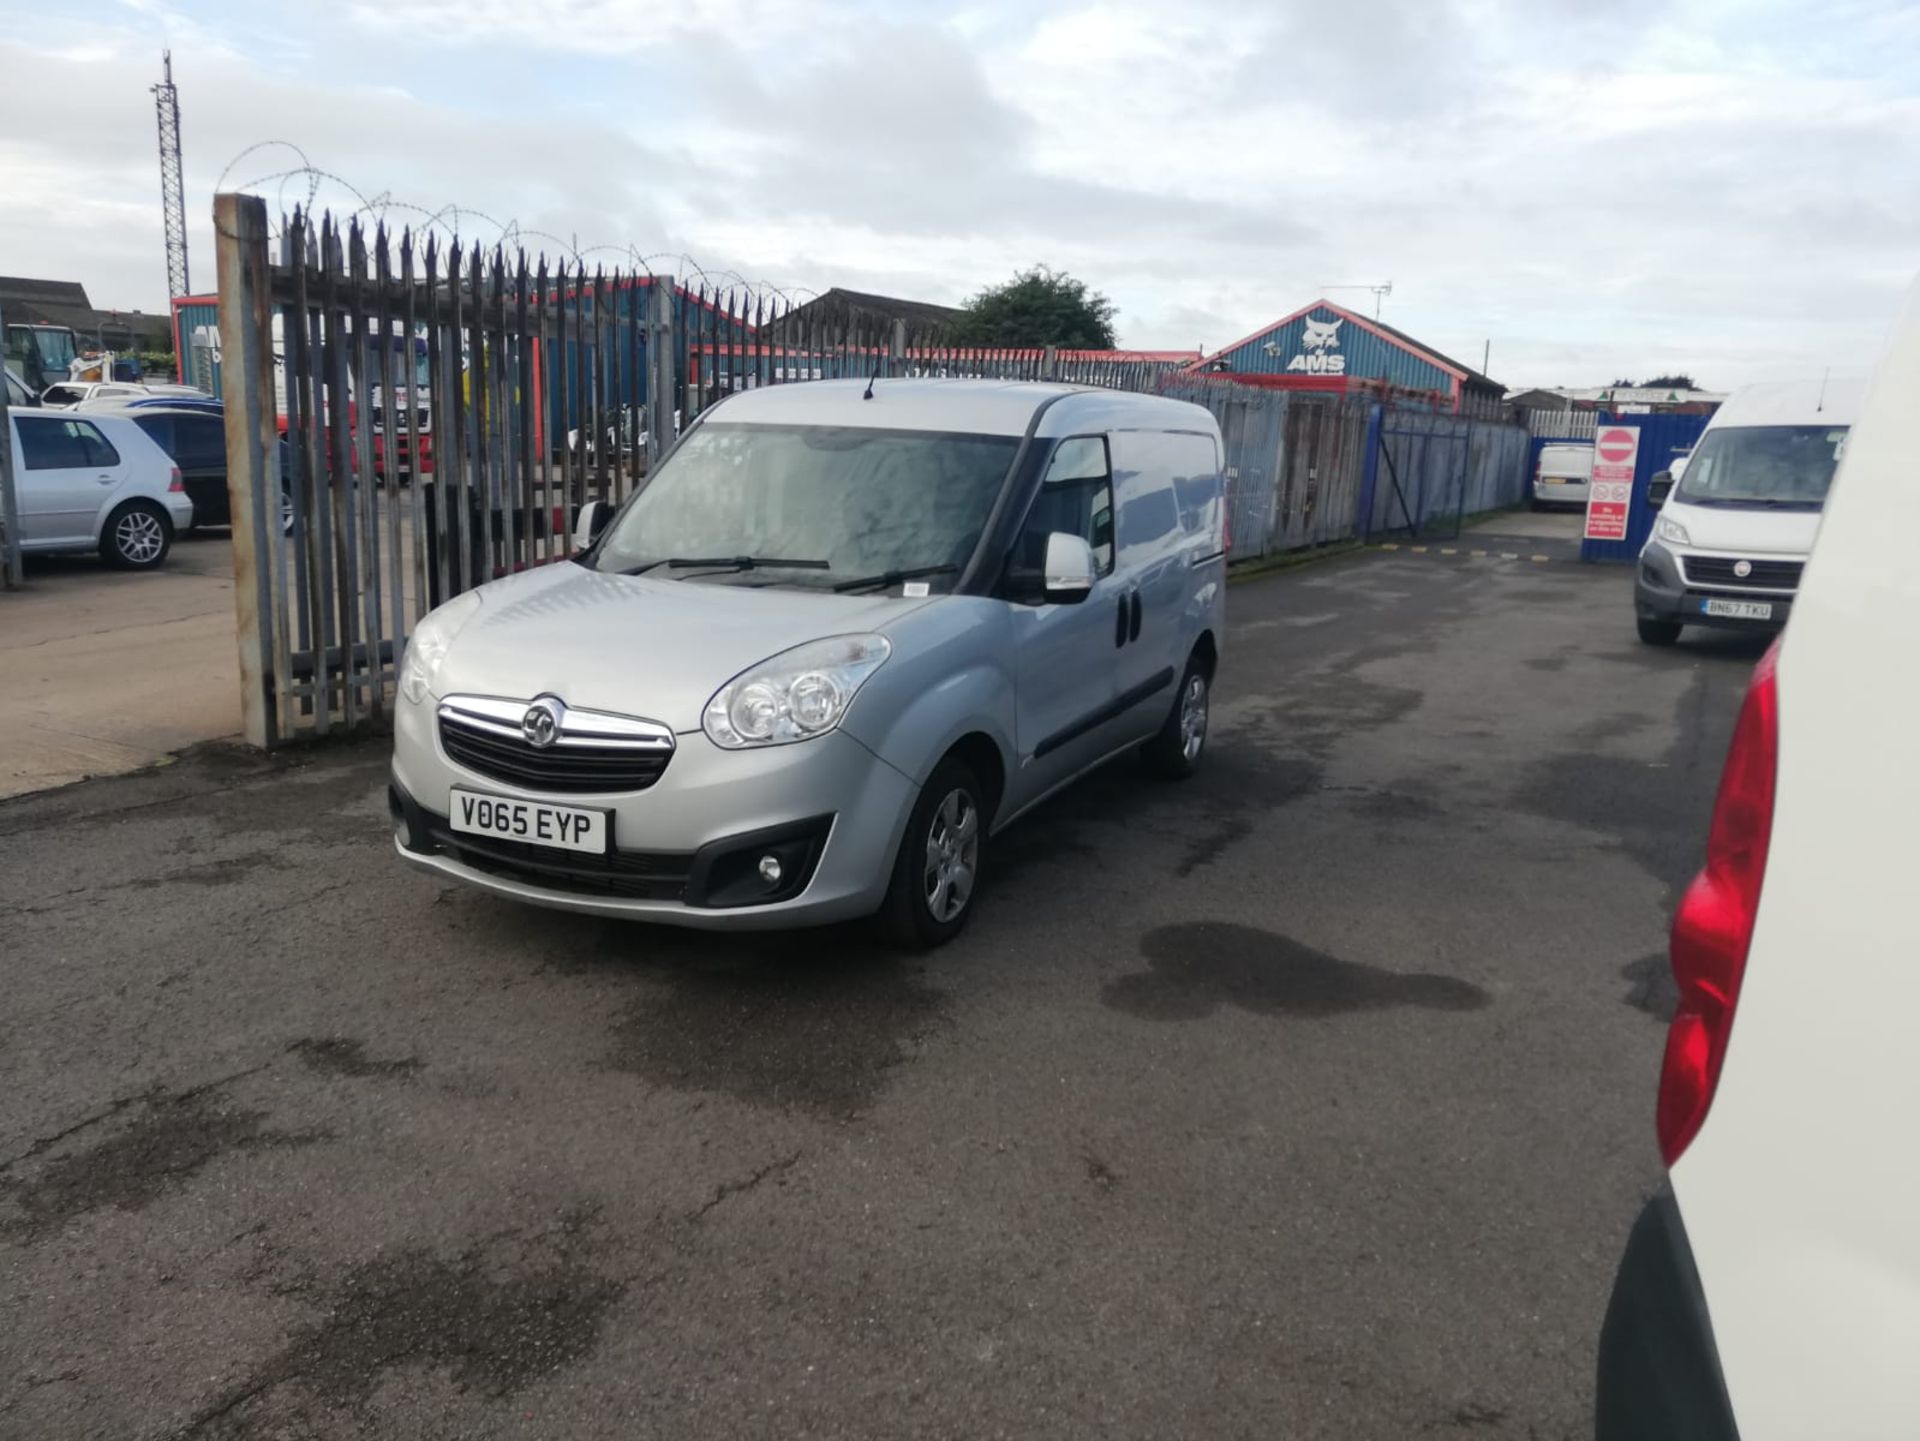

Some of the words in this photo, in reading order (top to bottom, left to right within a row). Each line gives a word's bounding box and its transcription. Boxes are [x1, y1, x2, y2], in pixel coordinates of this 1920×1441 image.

[1286, 354, 1345, 370] AMS
[1710, 602, 1741, 615] BN67
[1745, 604, 1769, 616] TKU
[537, 808, 590, 843] EYP
